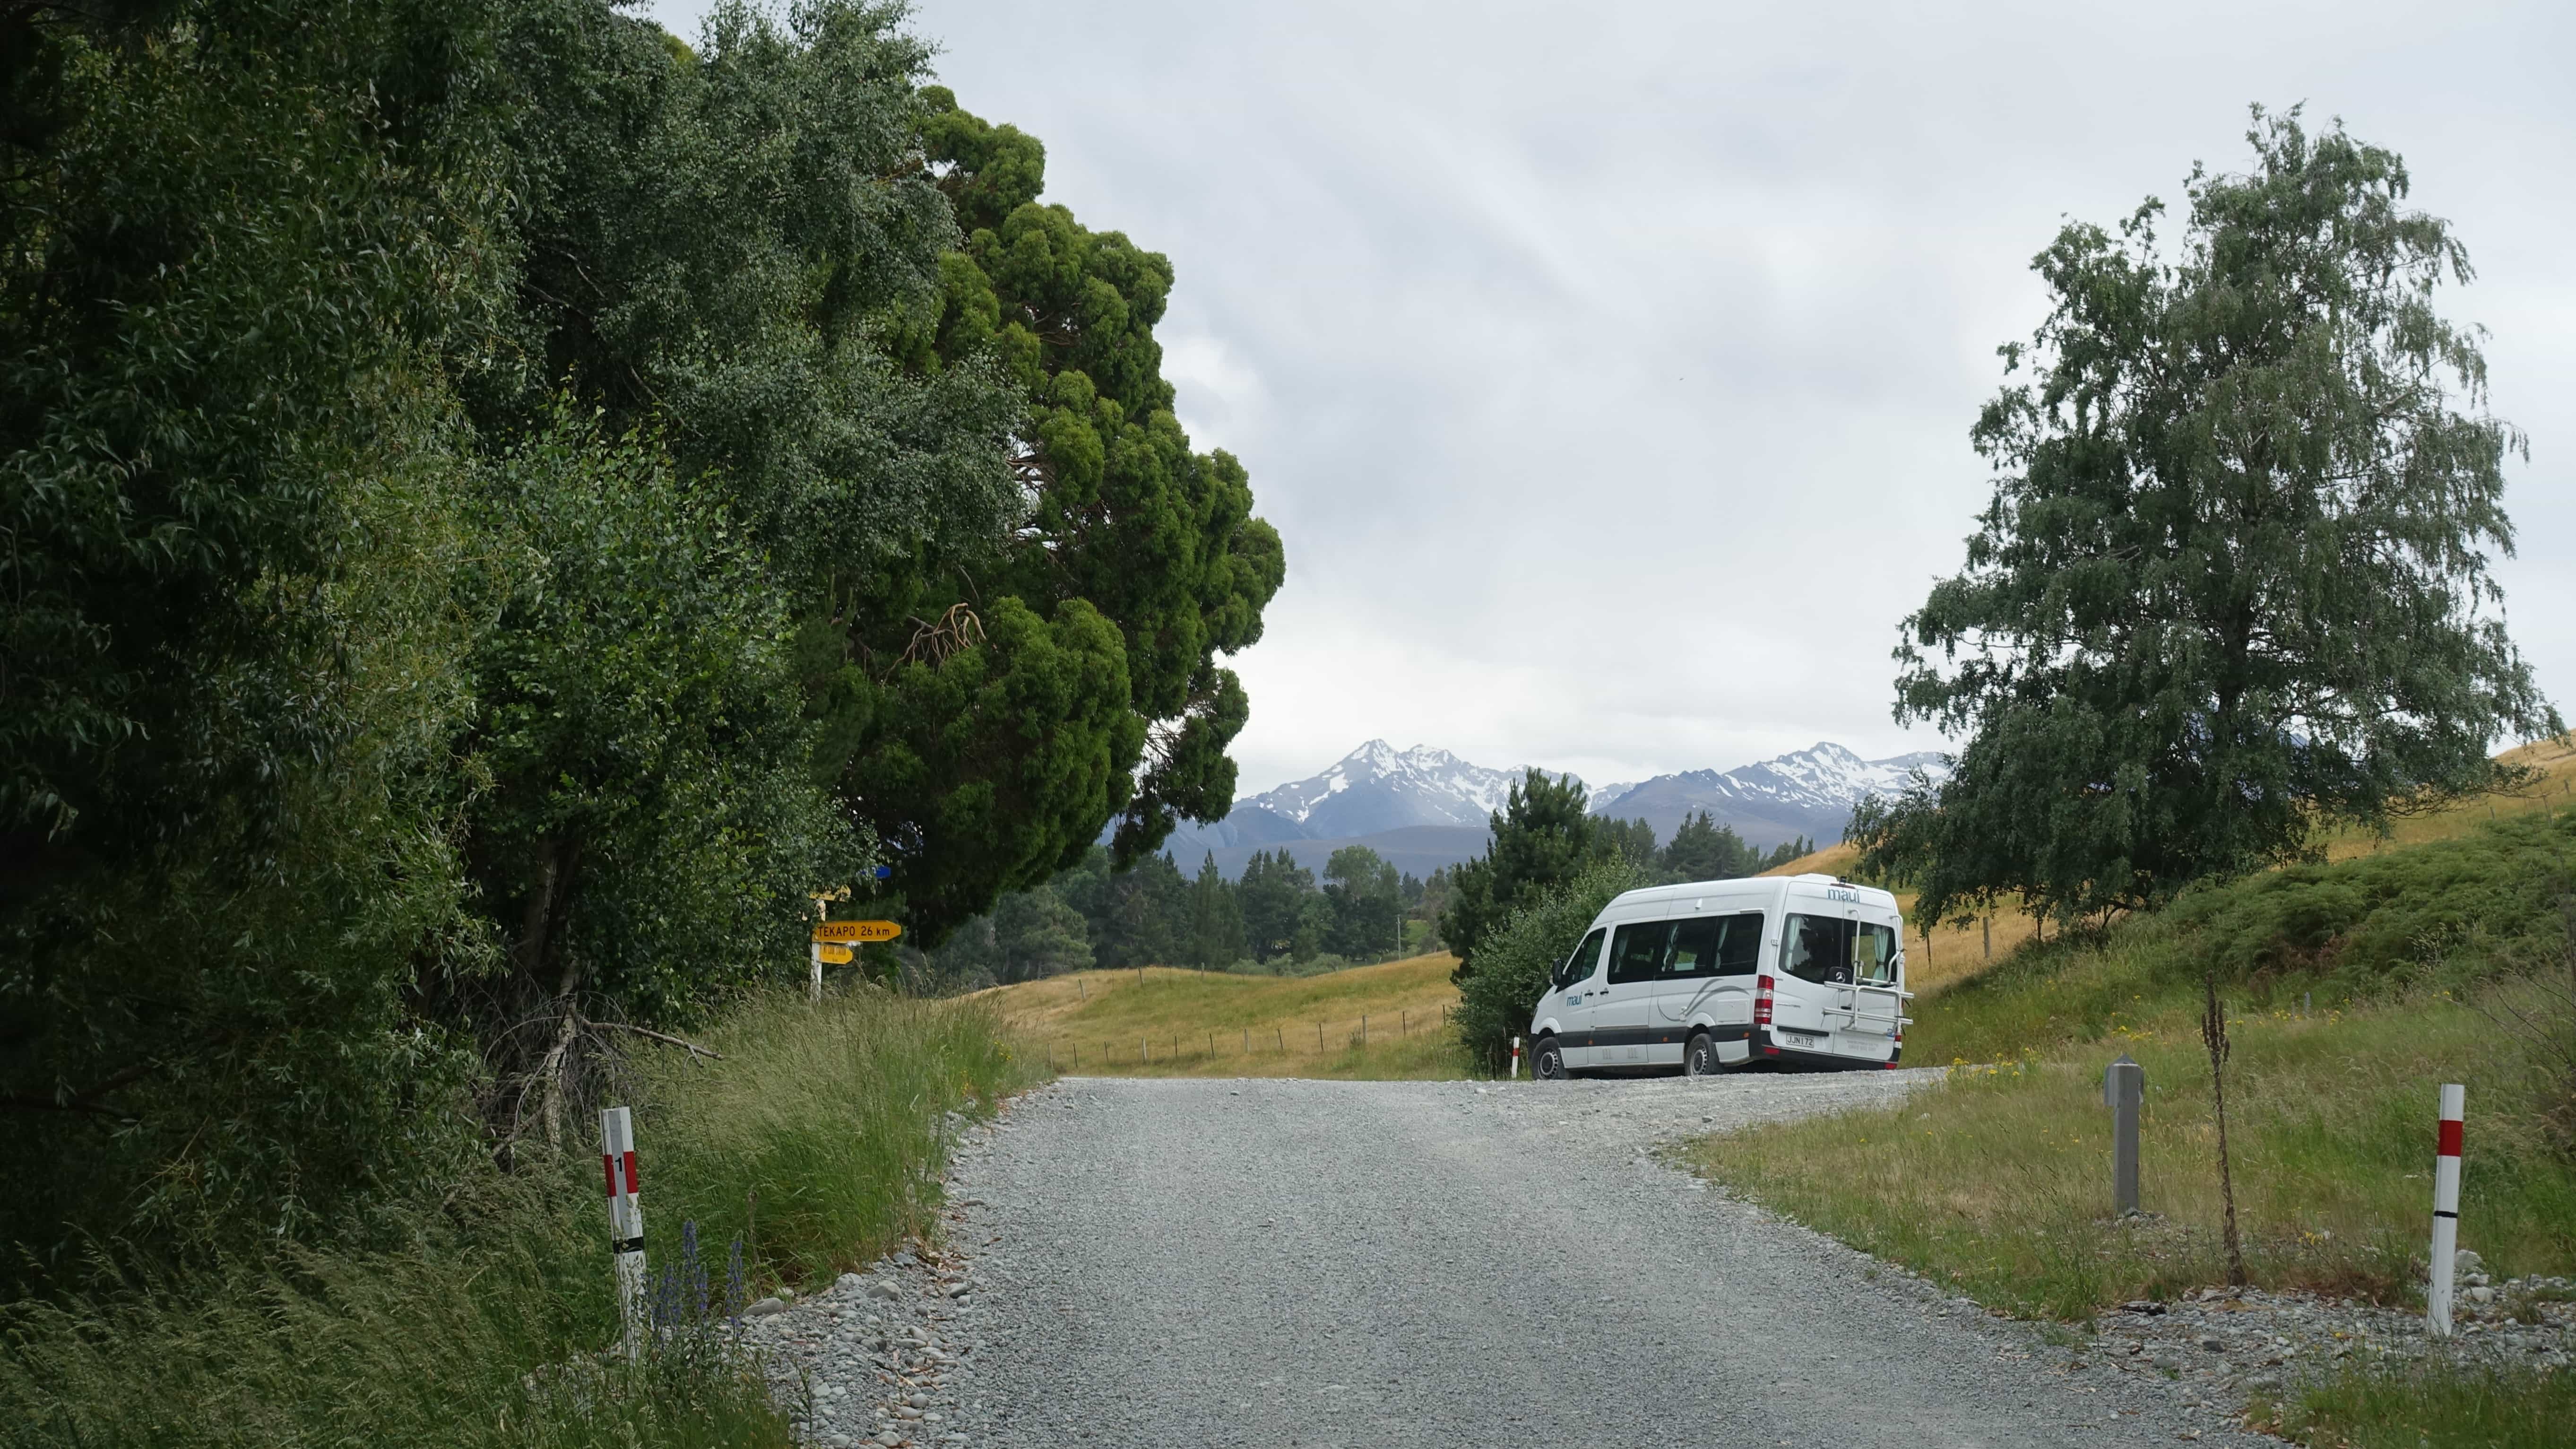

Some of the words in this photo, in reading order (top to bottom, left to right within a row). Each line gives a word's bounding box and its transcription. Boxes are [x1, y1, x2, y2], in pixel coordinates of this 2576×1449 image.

[1827, 888, 1860, 903] maui
[818, 926, 856, 937] TEKAPO
[861, 925, 873, 937] 26
[876, 927, 890, 936] km
[1566, 991, 1582, 1006] maui
[1788, 1036, 1813, 1046] JJN172
[615, 1157, 622, 1172] 1
